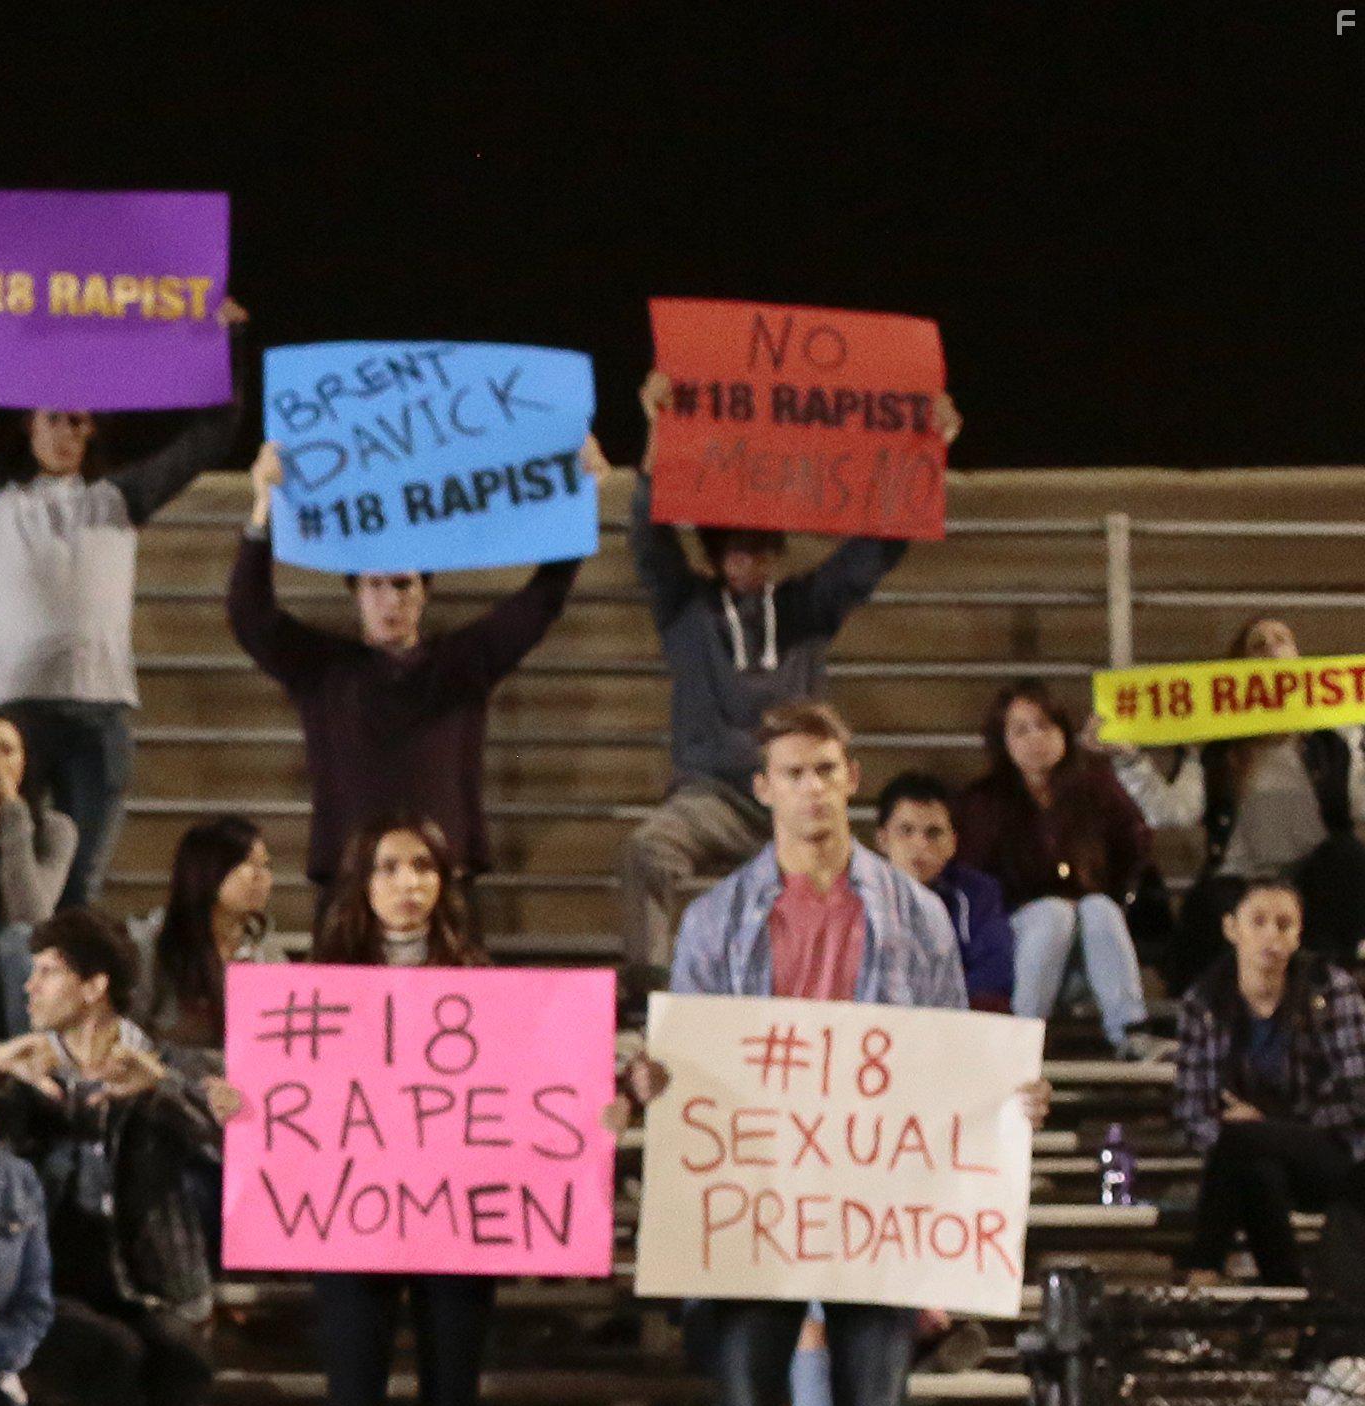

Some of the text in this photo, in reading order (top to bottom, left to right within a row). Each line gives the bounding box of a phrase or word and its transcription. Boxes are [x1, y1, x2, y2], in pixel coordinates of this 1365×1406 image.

[48, 271, 213, 321] RAPIST
[747, 312, 848, 371] NO
[273, 344, 459, 433] BRENT
[279, 363, 559, 493] DAVICK
[671, 379, 933, 435] #18 RAPIST
[297, 450, 584, 540] #18 RAPIST
[1115, 677, 1194, 719] #18
[255, 987, 479, 1077] #18
[740, 1022, 895, 1099] #18
[262, 1077, 587, 1161] RAPES
[679, 1095, 1000, 1176] SEXUAL
[259, 1156, 575, 1251] WOMEN
[699, 1181, 1020, 1278] PREDATOR
